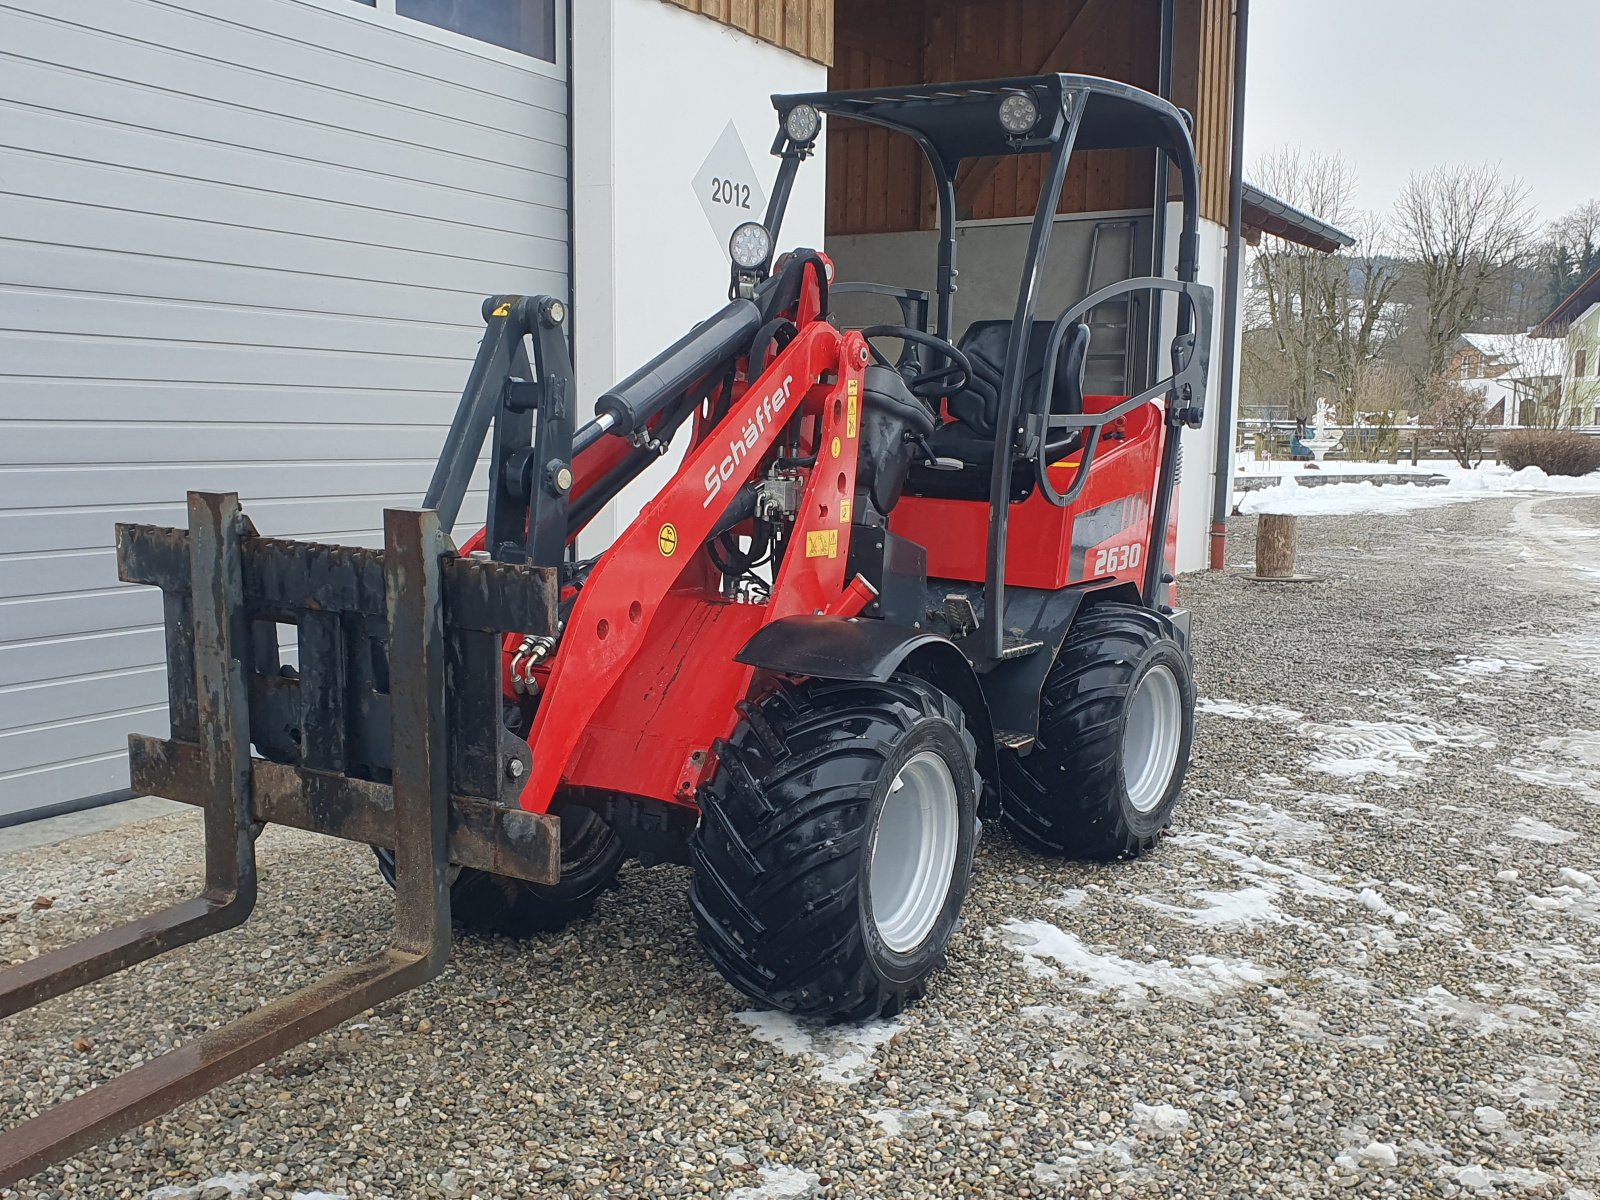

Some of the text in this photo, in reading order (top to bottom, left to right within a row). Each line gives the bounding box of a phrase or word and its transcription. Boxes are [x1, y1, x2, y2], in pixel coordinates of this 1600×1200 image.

[711, 177, 751, 210] 2012
[703, 375, 793, 509] Schäffer
[1094, 543, 1142, 576] 2630
